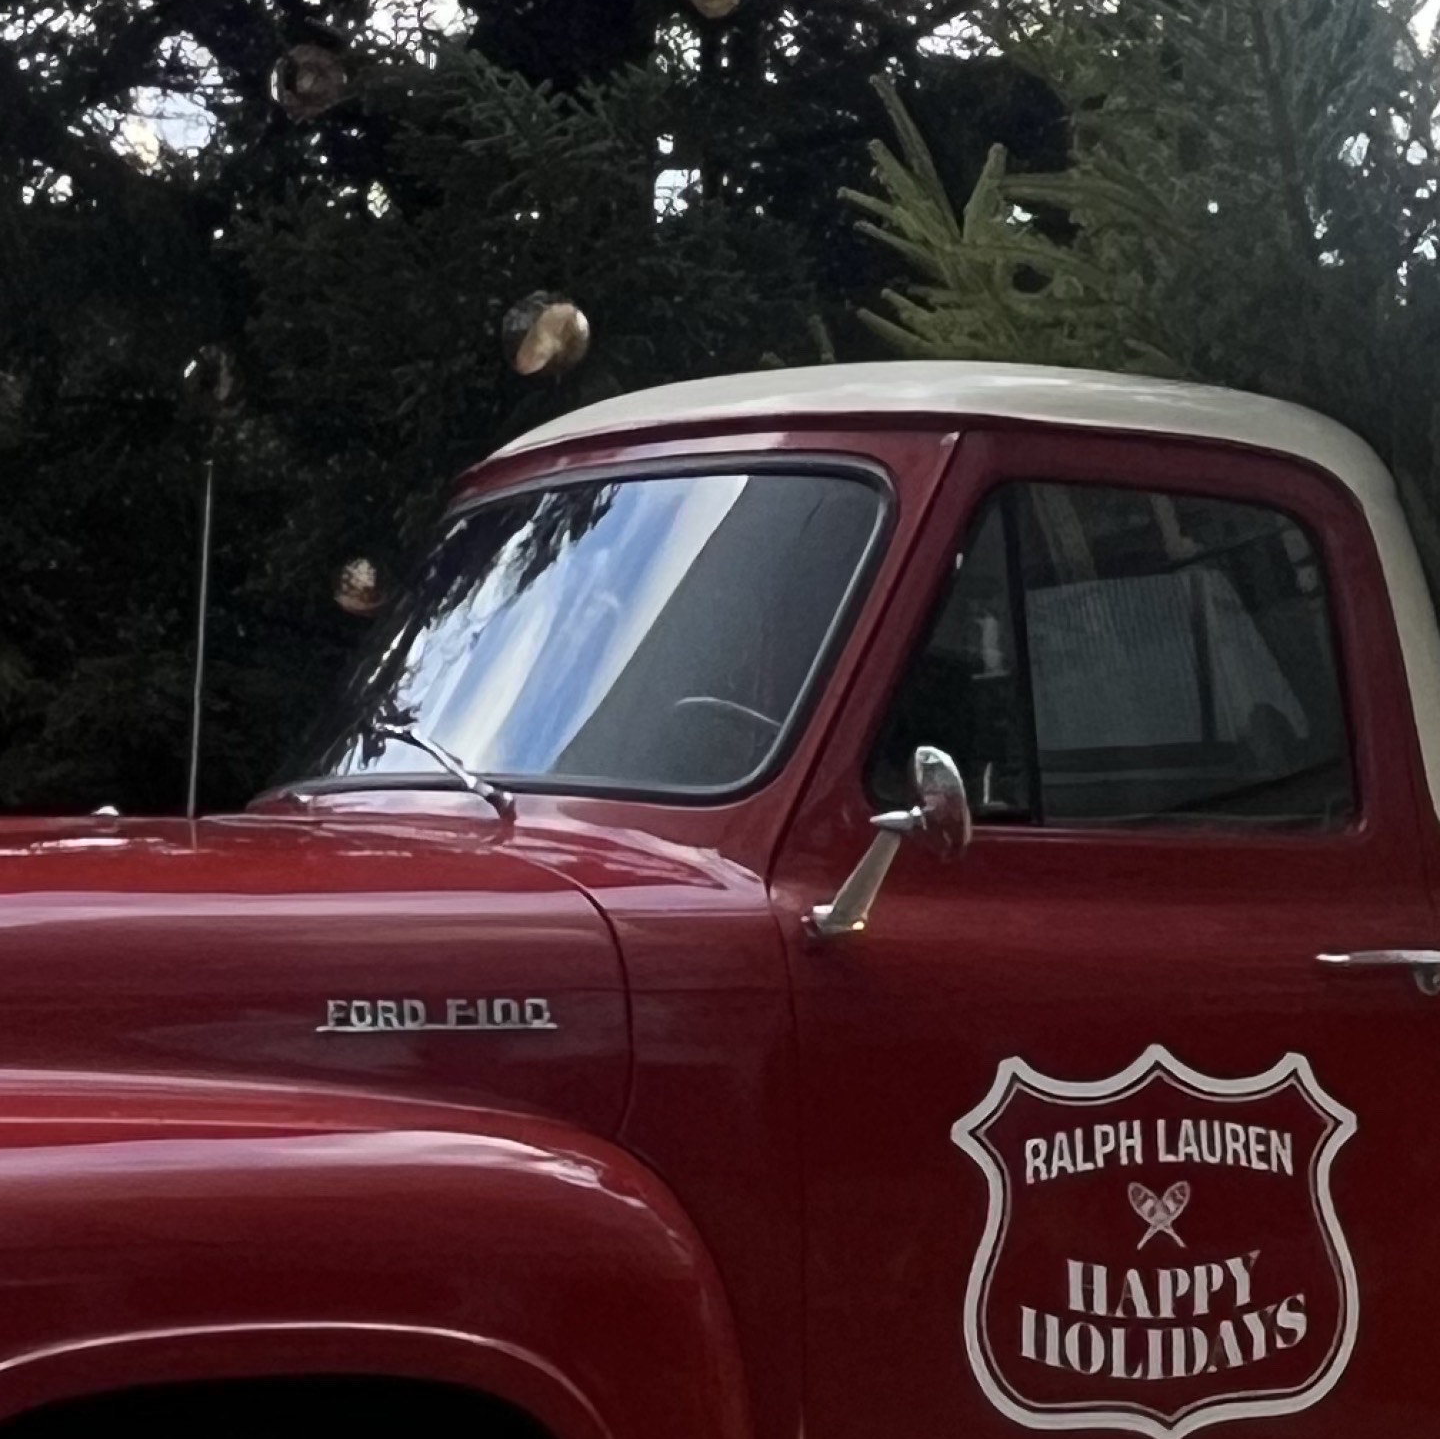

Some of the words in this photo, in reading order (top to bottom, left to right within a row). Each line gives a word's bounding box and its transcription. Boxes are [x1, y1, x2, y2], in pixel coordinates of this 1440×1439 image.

[327, 999, 427, 1028] FORD
[1025, 1119, 1143, 1184] RALPH
[1157, 1118, 1293, 1176] LAUREN
[1066, 1249, 1261, 1319] HAPPY
[1019, 1293, 1307, 1380] HOLIDAYS
